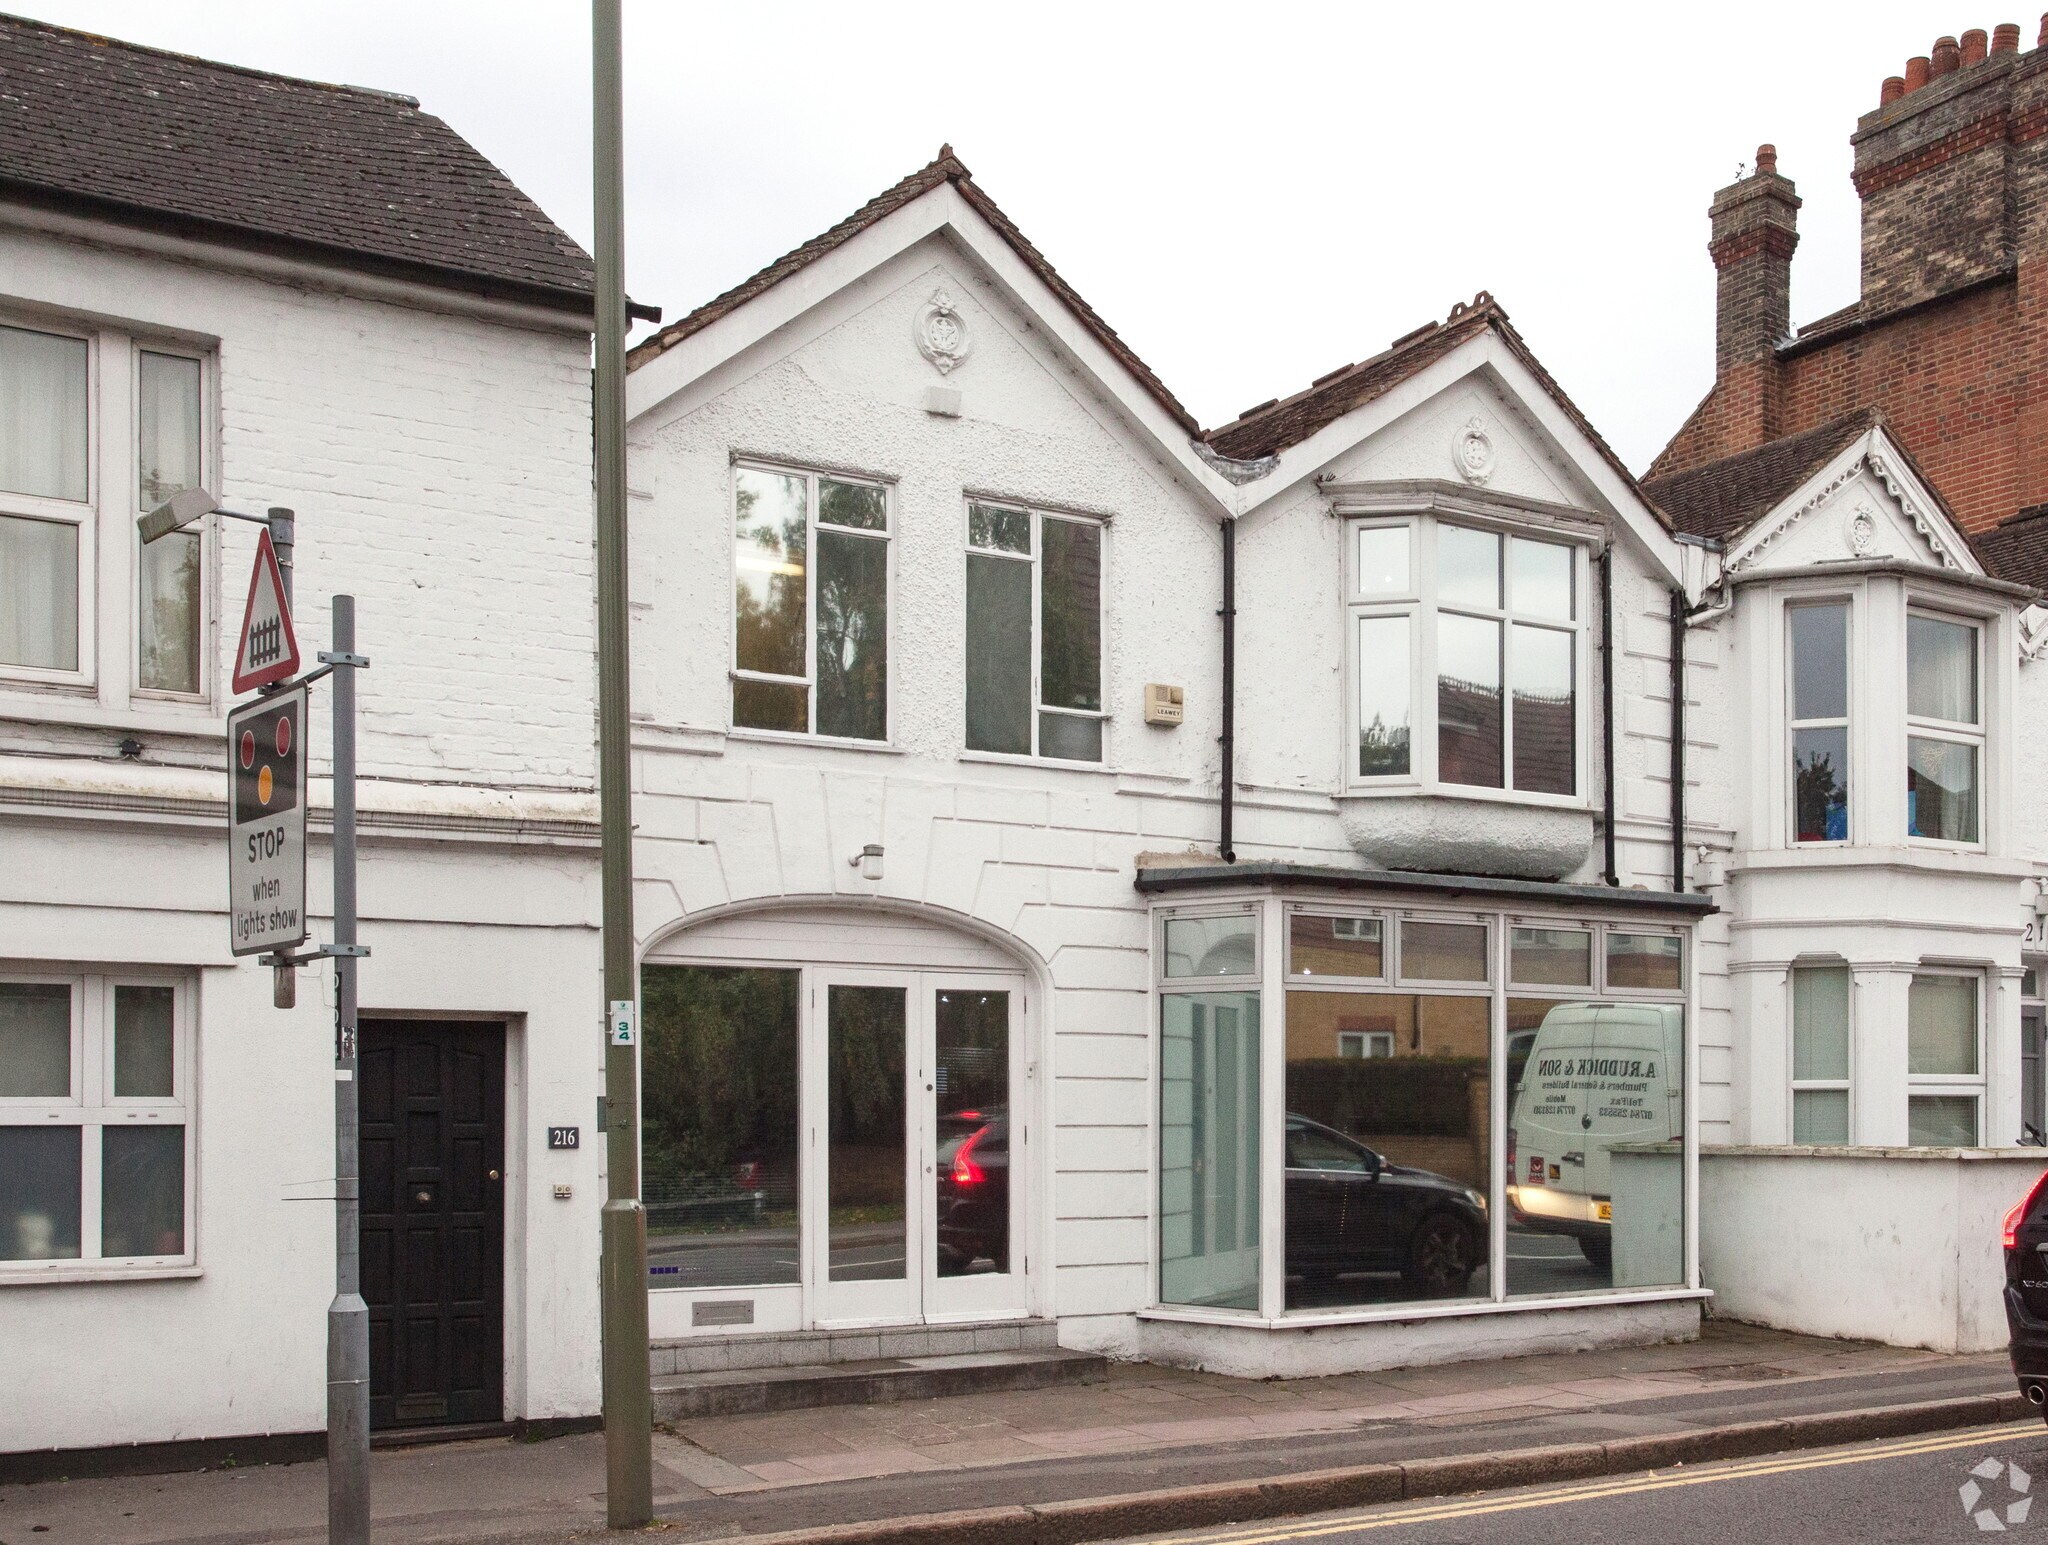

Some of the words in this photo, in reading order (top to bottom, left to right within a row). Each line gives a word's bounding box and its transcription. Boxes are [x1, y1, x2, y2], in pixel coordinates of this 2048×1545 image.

[1157, 709, 1181, 717] LEAWEY
[248, 826, 285, 863] STOP
[252, 876, 280, 901] when
[237, 910, 266, 941] lights
[269, 906, 298, 931] show
[554, 1130, 575, 1145] 216
